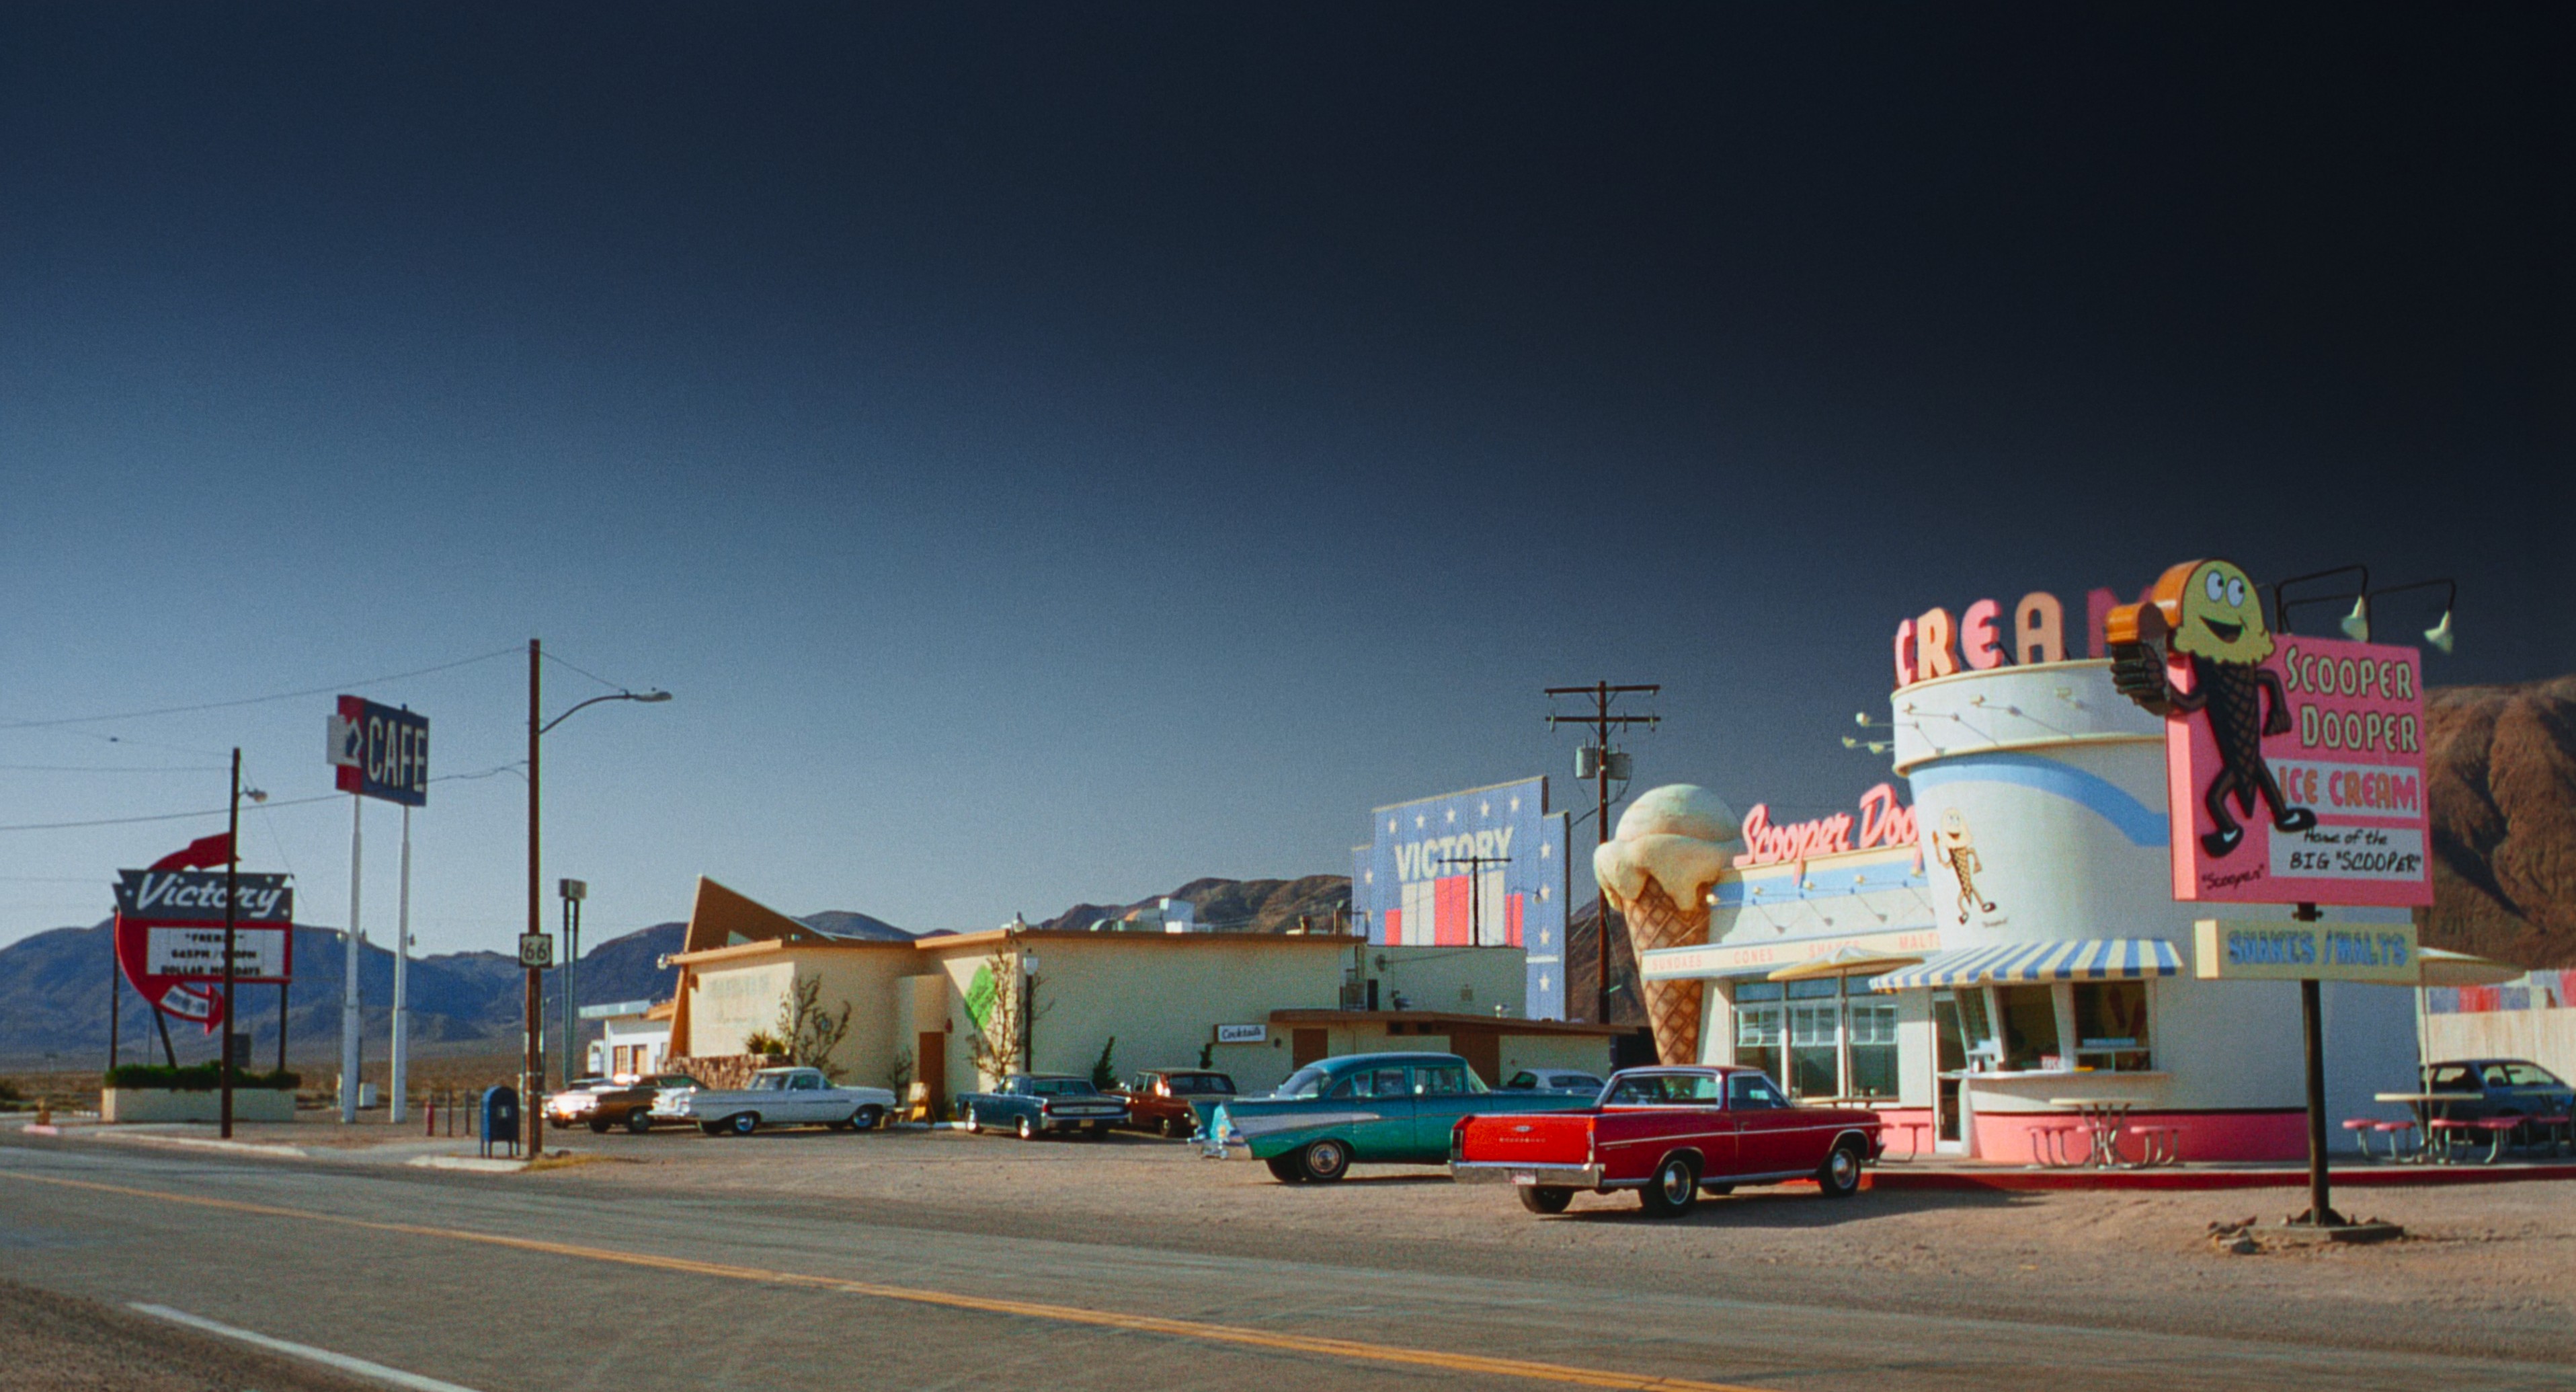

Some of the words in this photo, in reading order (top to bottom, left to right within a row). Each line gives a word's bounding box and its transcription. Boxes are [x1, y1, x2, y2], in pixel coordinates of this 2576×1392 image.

[2285, 644, 2415, 701] SCOOPER
[2301, 703, 2420, 754] DOOPER
[368, 716, 427, 792] CAFE
[2279, 767, 2318, 804] ICE
[2329, 770, 2418, 811] CREAM
[1394, 826, 1513, 882] VICTORY
[1732, 804, 1853, 886] Scooper
[2304, 828, 2340, 843] Home
[2344, 829, 2363, 844] of
[2365, 830, 2387, 845] the
[2290, 851, 2330, 870] BIG
[2336, 850, 2422, 872] "SCOOPER"
[136, 873, 282, 919] Victory
[210, 966, 260, 976] MODAYS
[524, 941, 549, 961] 66
[1652, 954, 1702, 970] SUNDAES
[1734, 948, 1773, 964] CONES
